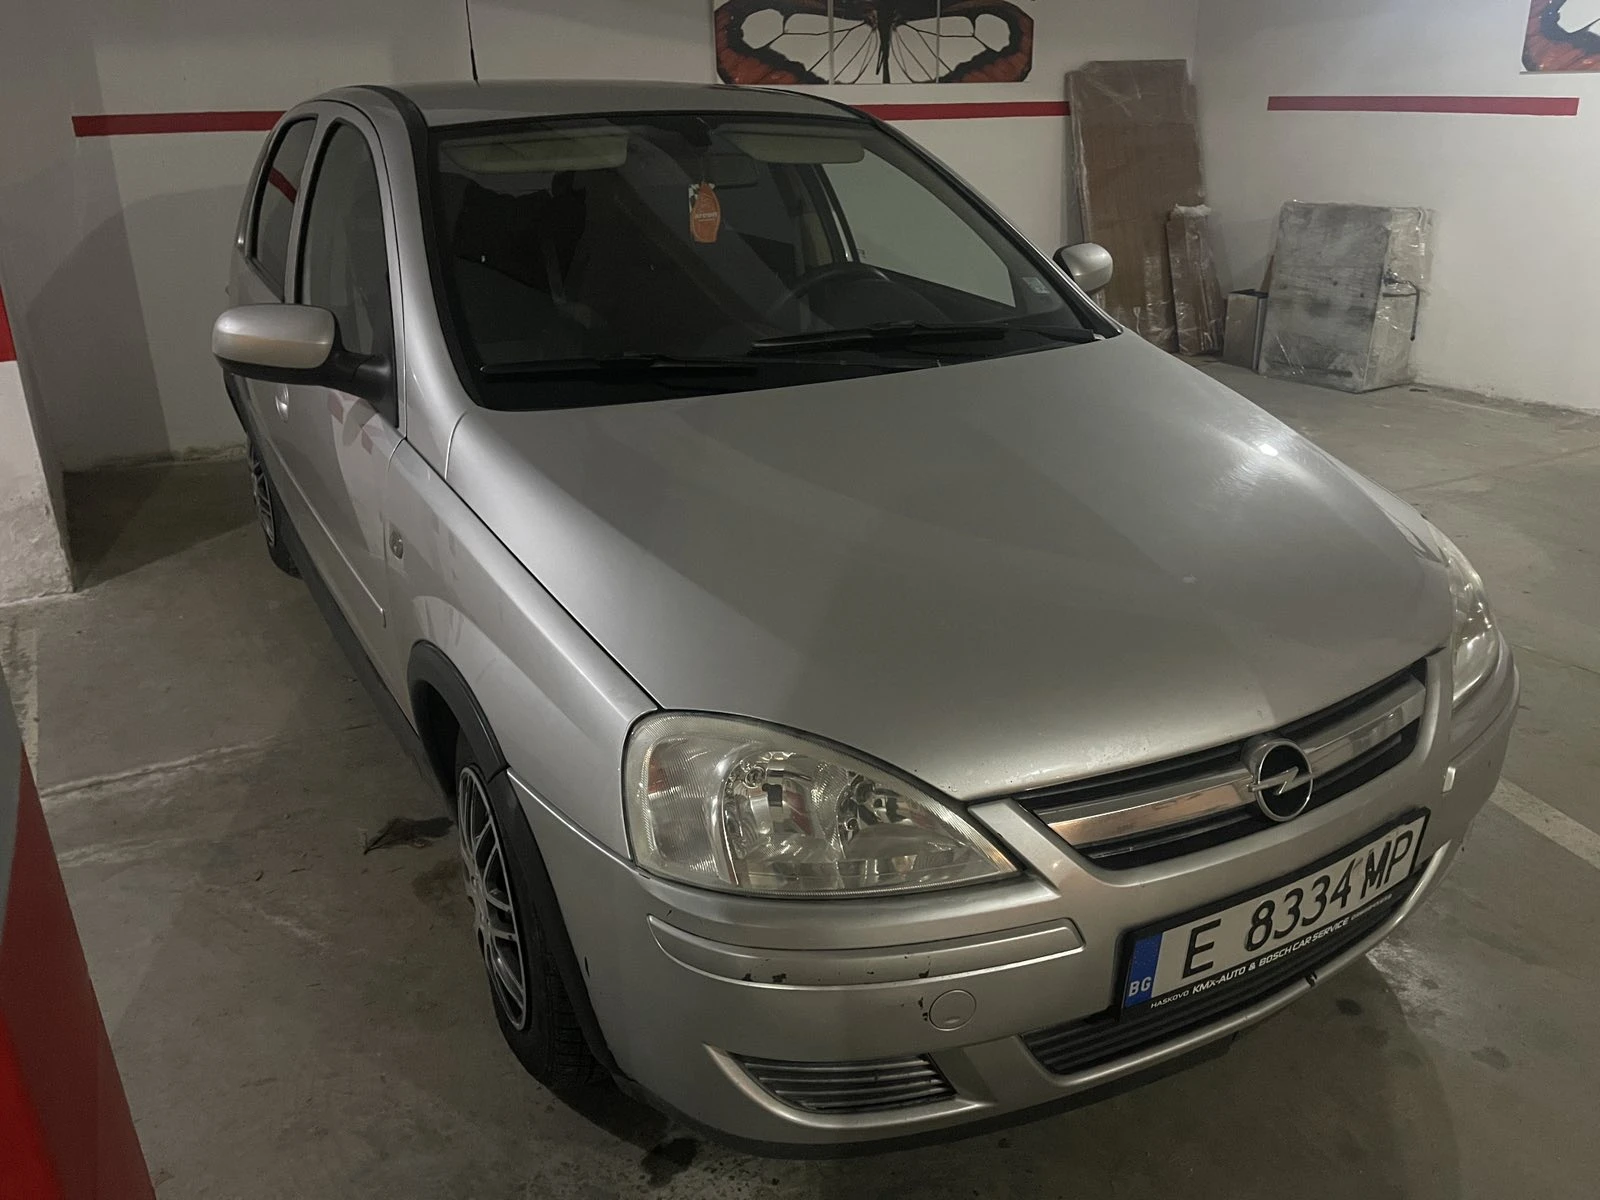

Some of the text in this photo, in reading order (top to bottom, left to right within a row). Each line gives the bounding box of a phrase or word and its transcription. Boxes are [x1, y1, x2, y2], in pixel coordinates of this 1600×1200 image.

[1182, 830, 1414, 979] E 8334 MP
[1128, 976, 1152, 997] BG
[1150, 990, 1190, 1009] HASKOVO
[1248, 962, 1256, 971] &
[1258, 945, 1293, 967] BOSCH
[1292, 937, 1313, 951] CAR
[1311, 916, 1350, 941] SERVICE
